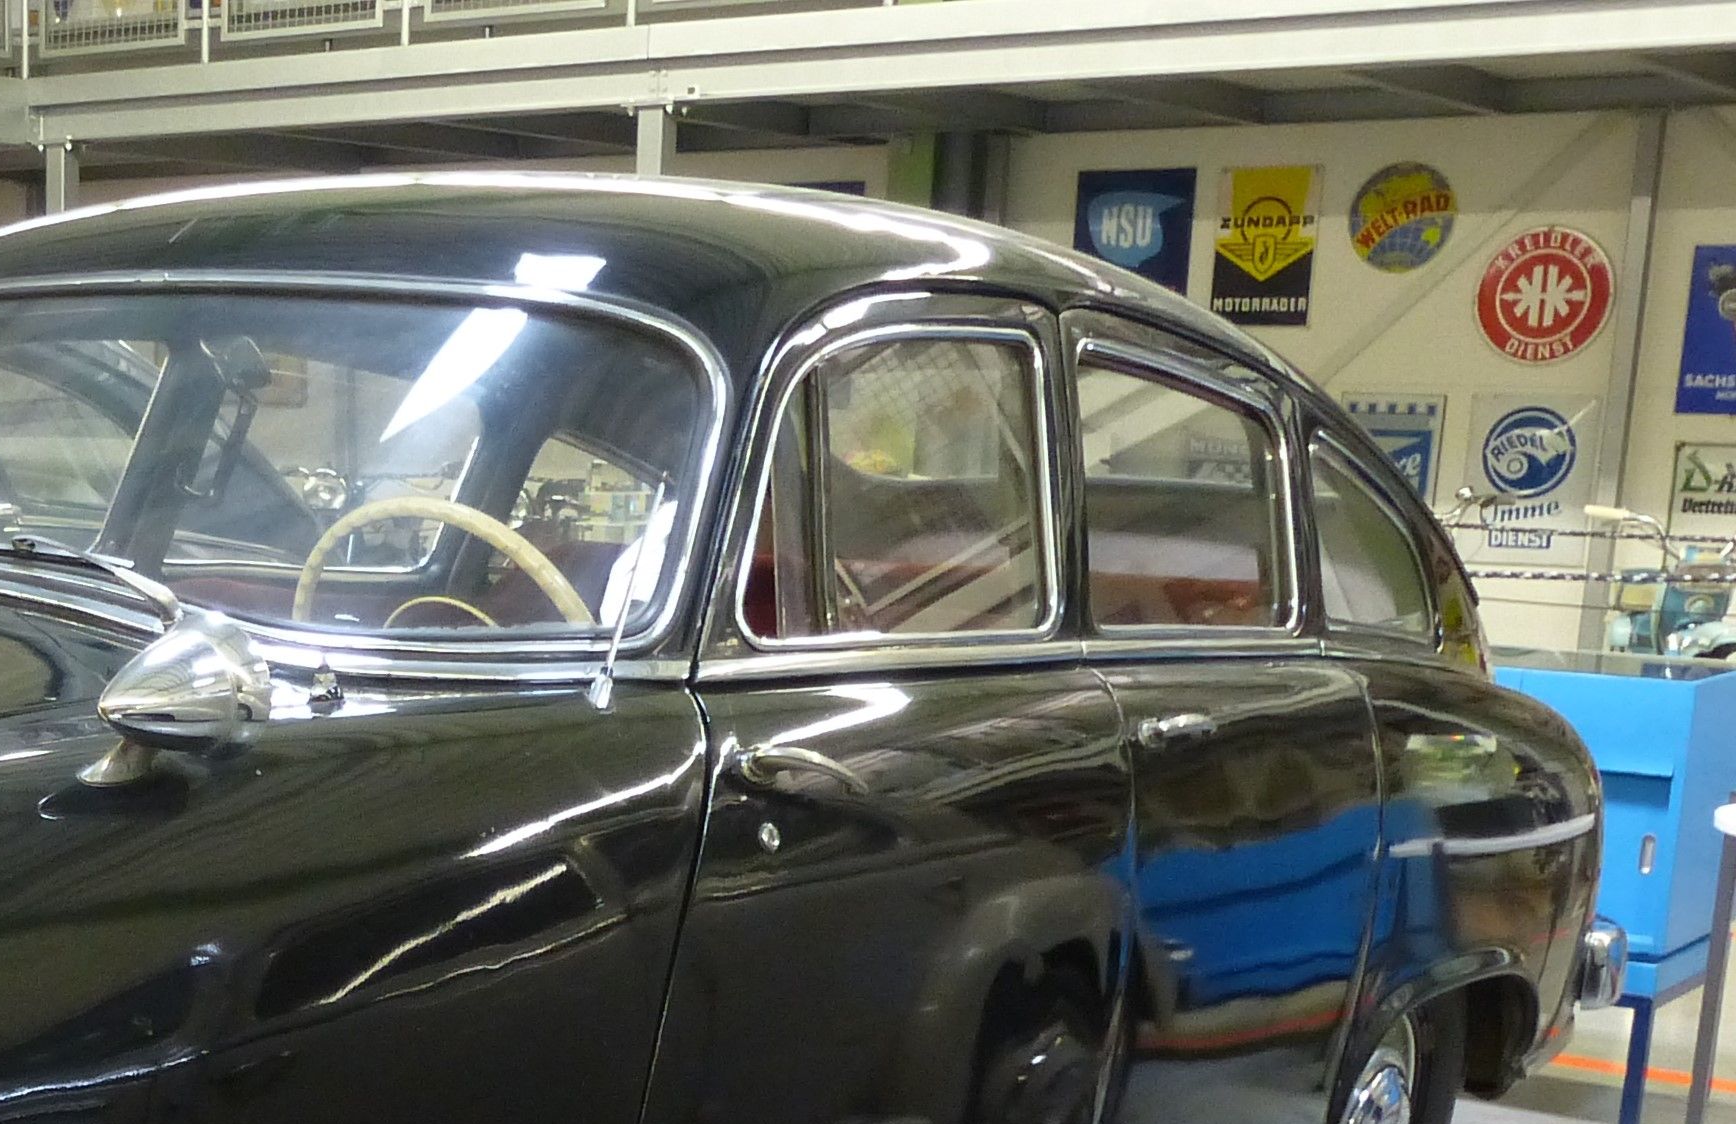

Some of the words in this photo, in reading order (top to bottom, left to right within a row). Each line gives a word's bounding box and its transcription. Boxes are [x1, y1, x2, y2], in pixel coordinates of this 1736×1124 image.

[1100, 202, 1154, 249] NSU
[1494, 230, 1601, 270] KREIDLER
[1505, 337, 1575, 360] DIENST
[1491, 432, 1549, 463] RIEDEL
[1490, 530, 1551, 548] DIENST
